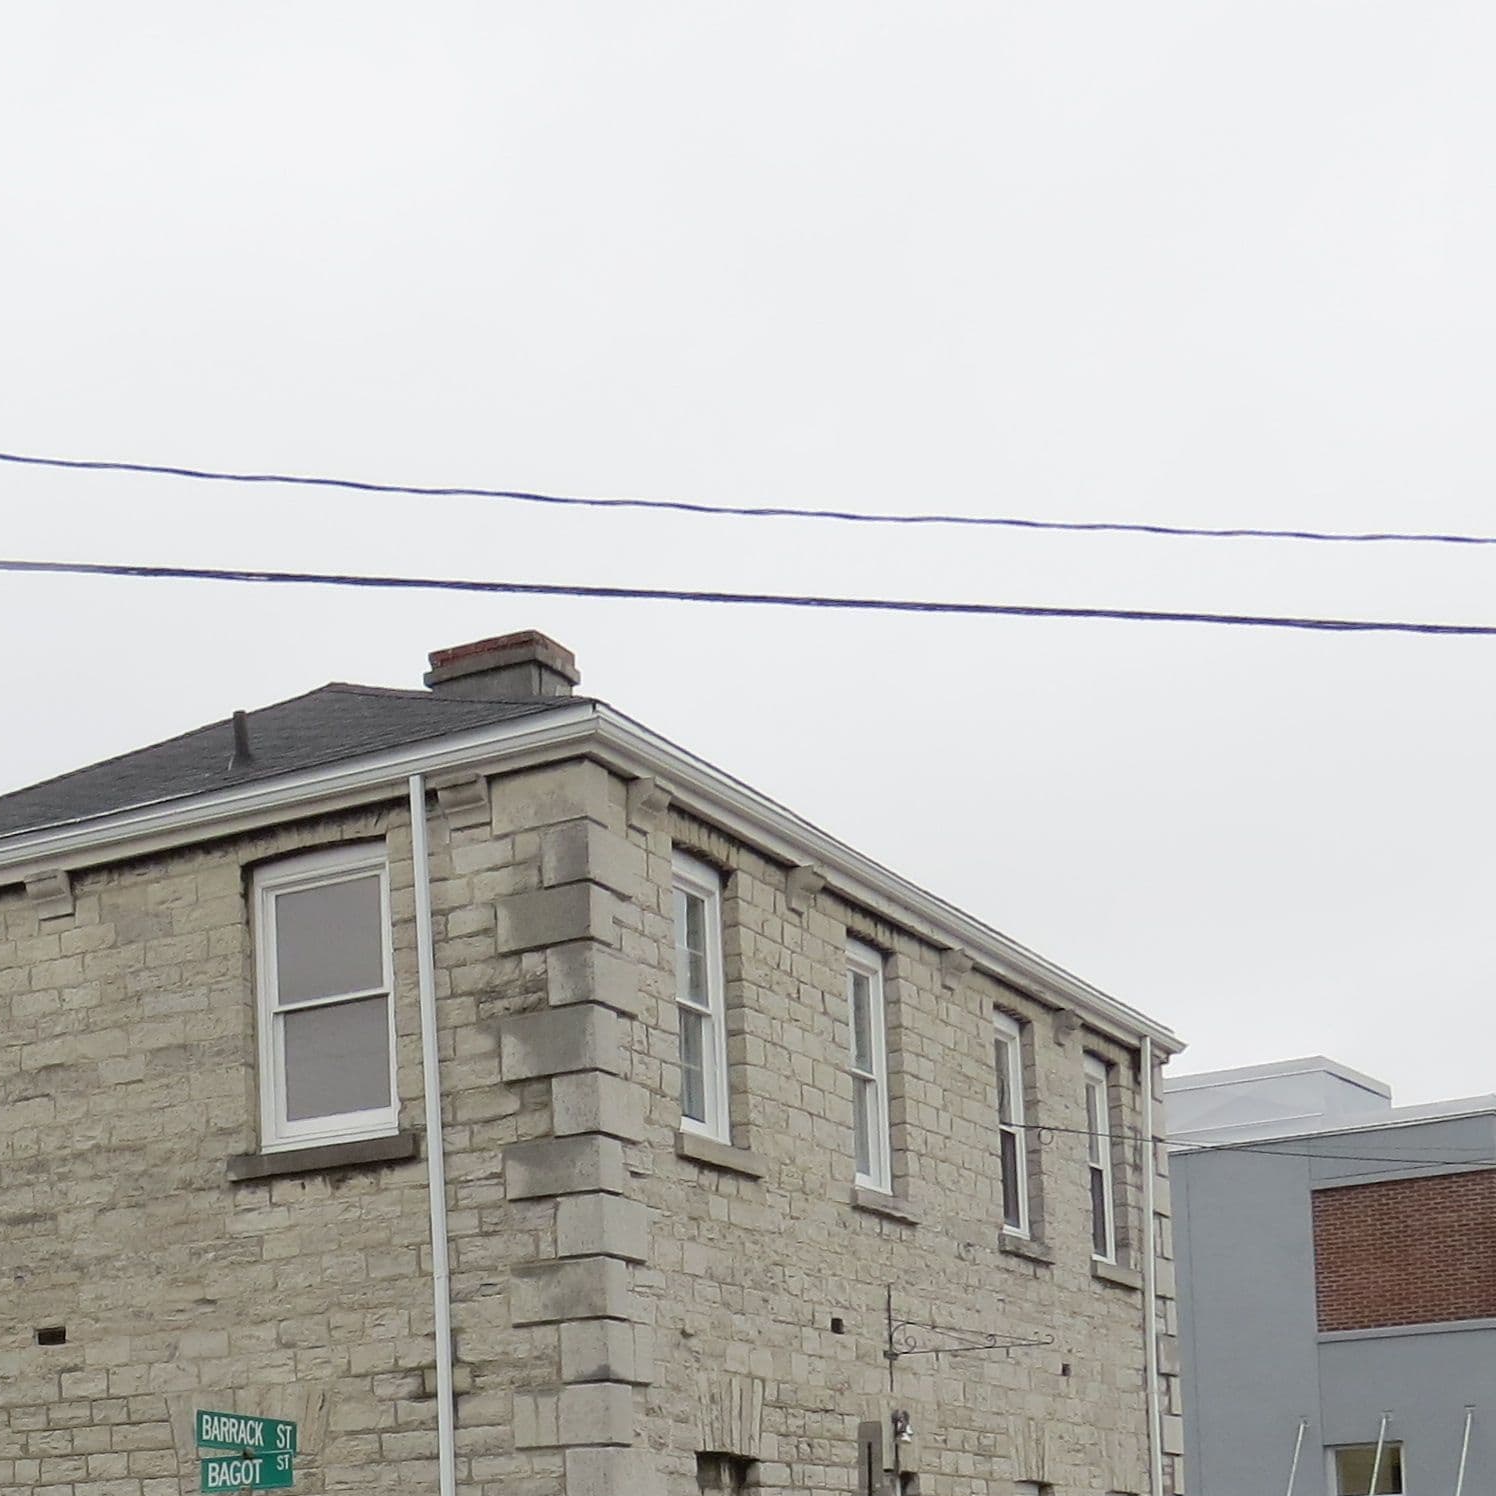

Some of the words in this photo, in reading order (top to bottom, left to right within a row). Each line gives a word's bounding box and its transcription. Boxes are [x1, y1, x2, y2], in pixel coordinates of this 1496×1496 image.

[202, 1414, 264, 1447] BARRACK
[276, 1424, 292, 1449] ST
[207, 1459, 263, 1487] BAGOT
[276, 1455, 289, 1470] ST
